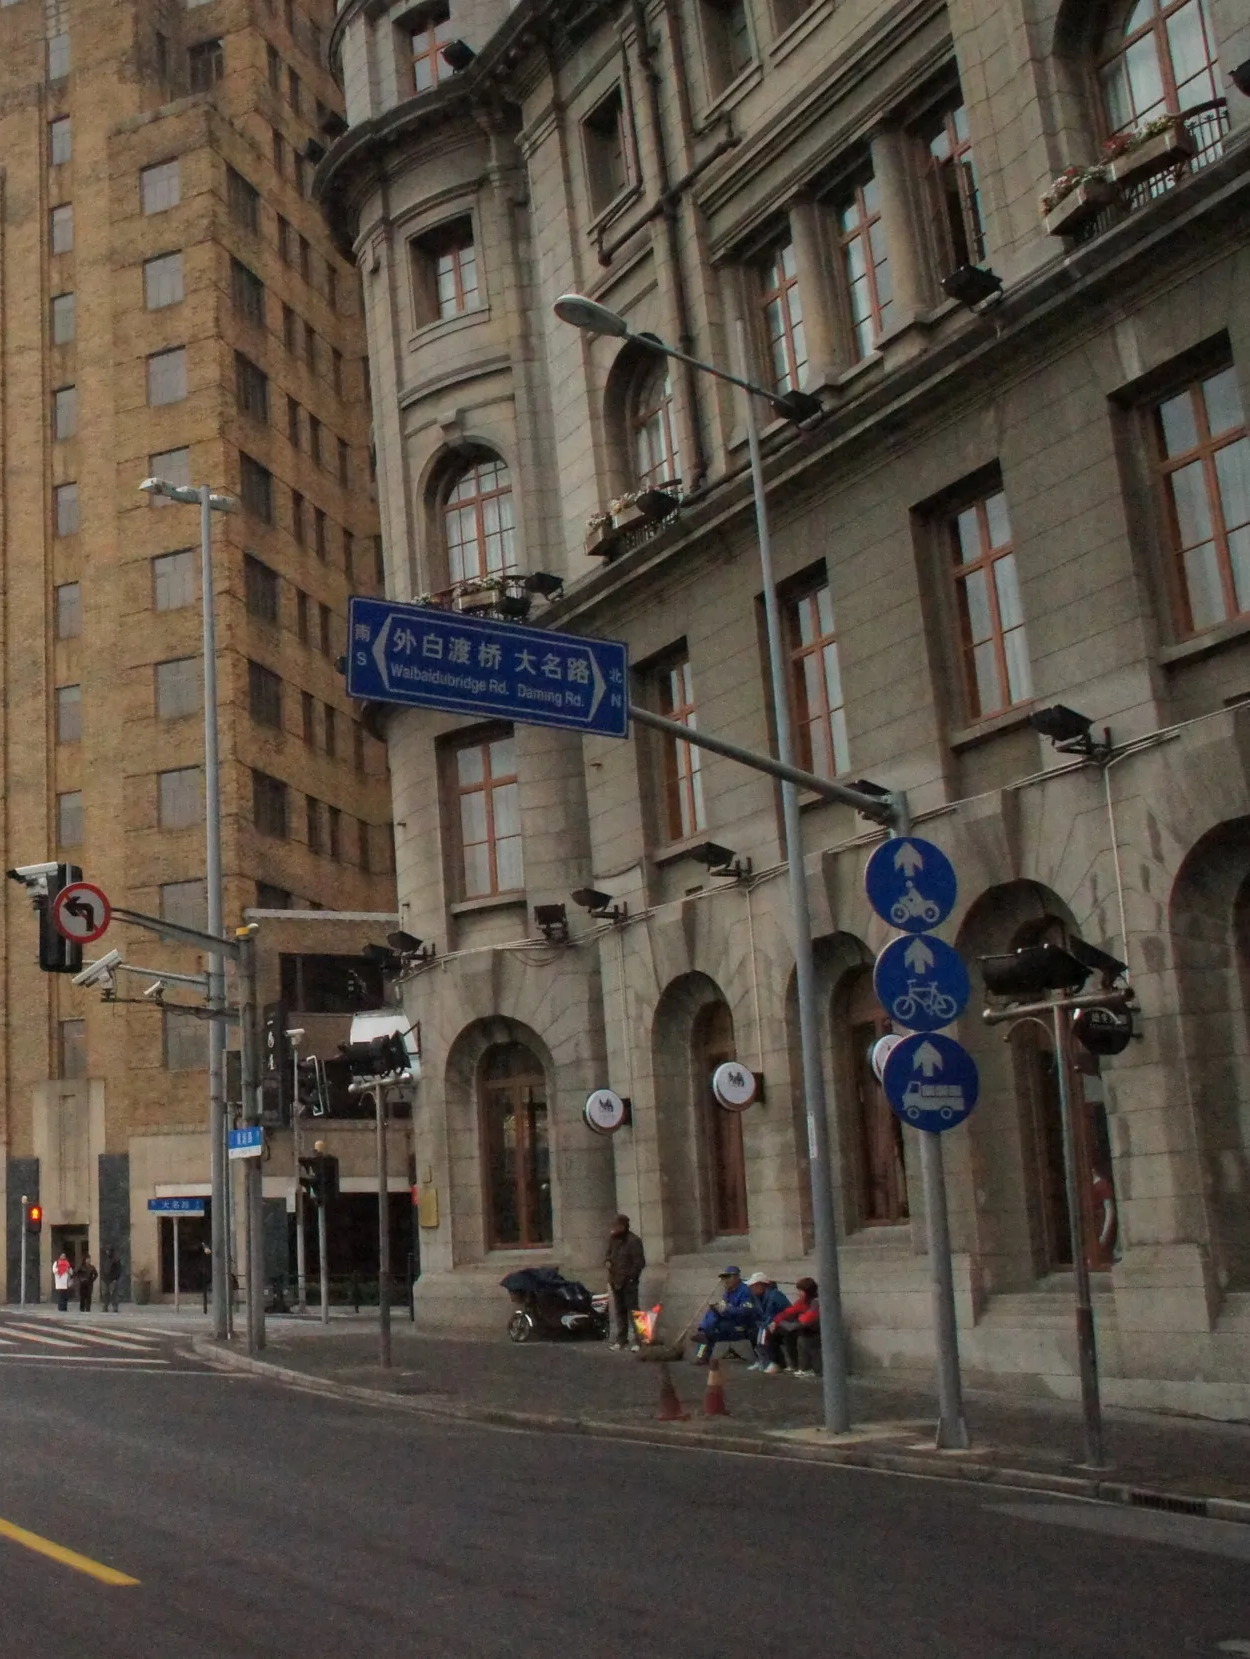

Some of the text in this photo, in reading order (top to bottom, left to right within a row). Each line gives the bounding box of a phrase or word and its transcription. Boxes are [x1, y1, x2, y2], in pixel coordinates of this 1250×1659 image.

[355, 624, 370, 642] 南
[357, 651, 367, 666] S
[392, 627, 590, 685] 外白渡桥 大名路
[609, 668, 623, 684] 北
[391, 662, 585, 708] Waibaidubridge Rd. Daming Rd.
[610, 693, 622, 708] N
